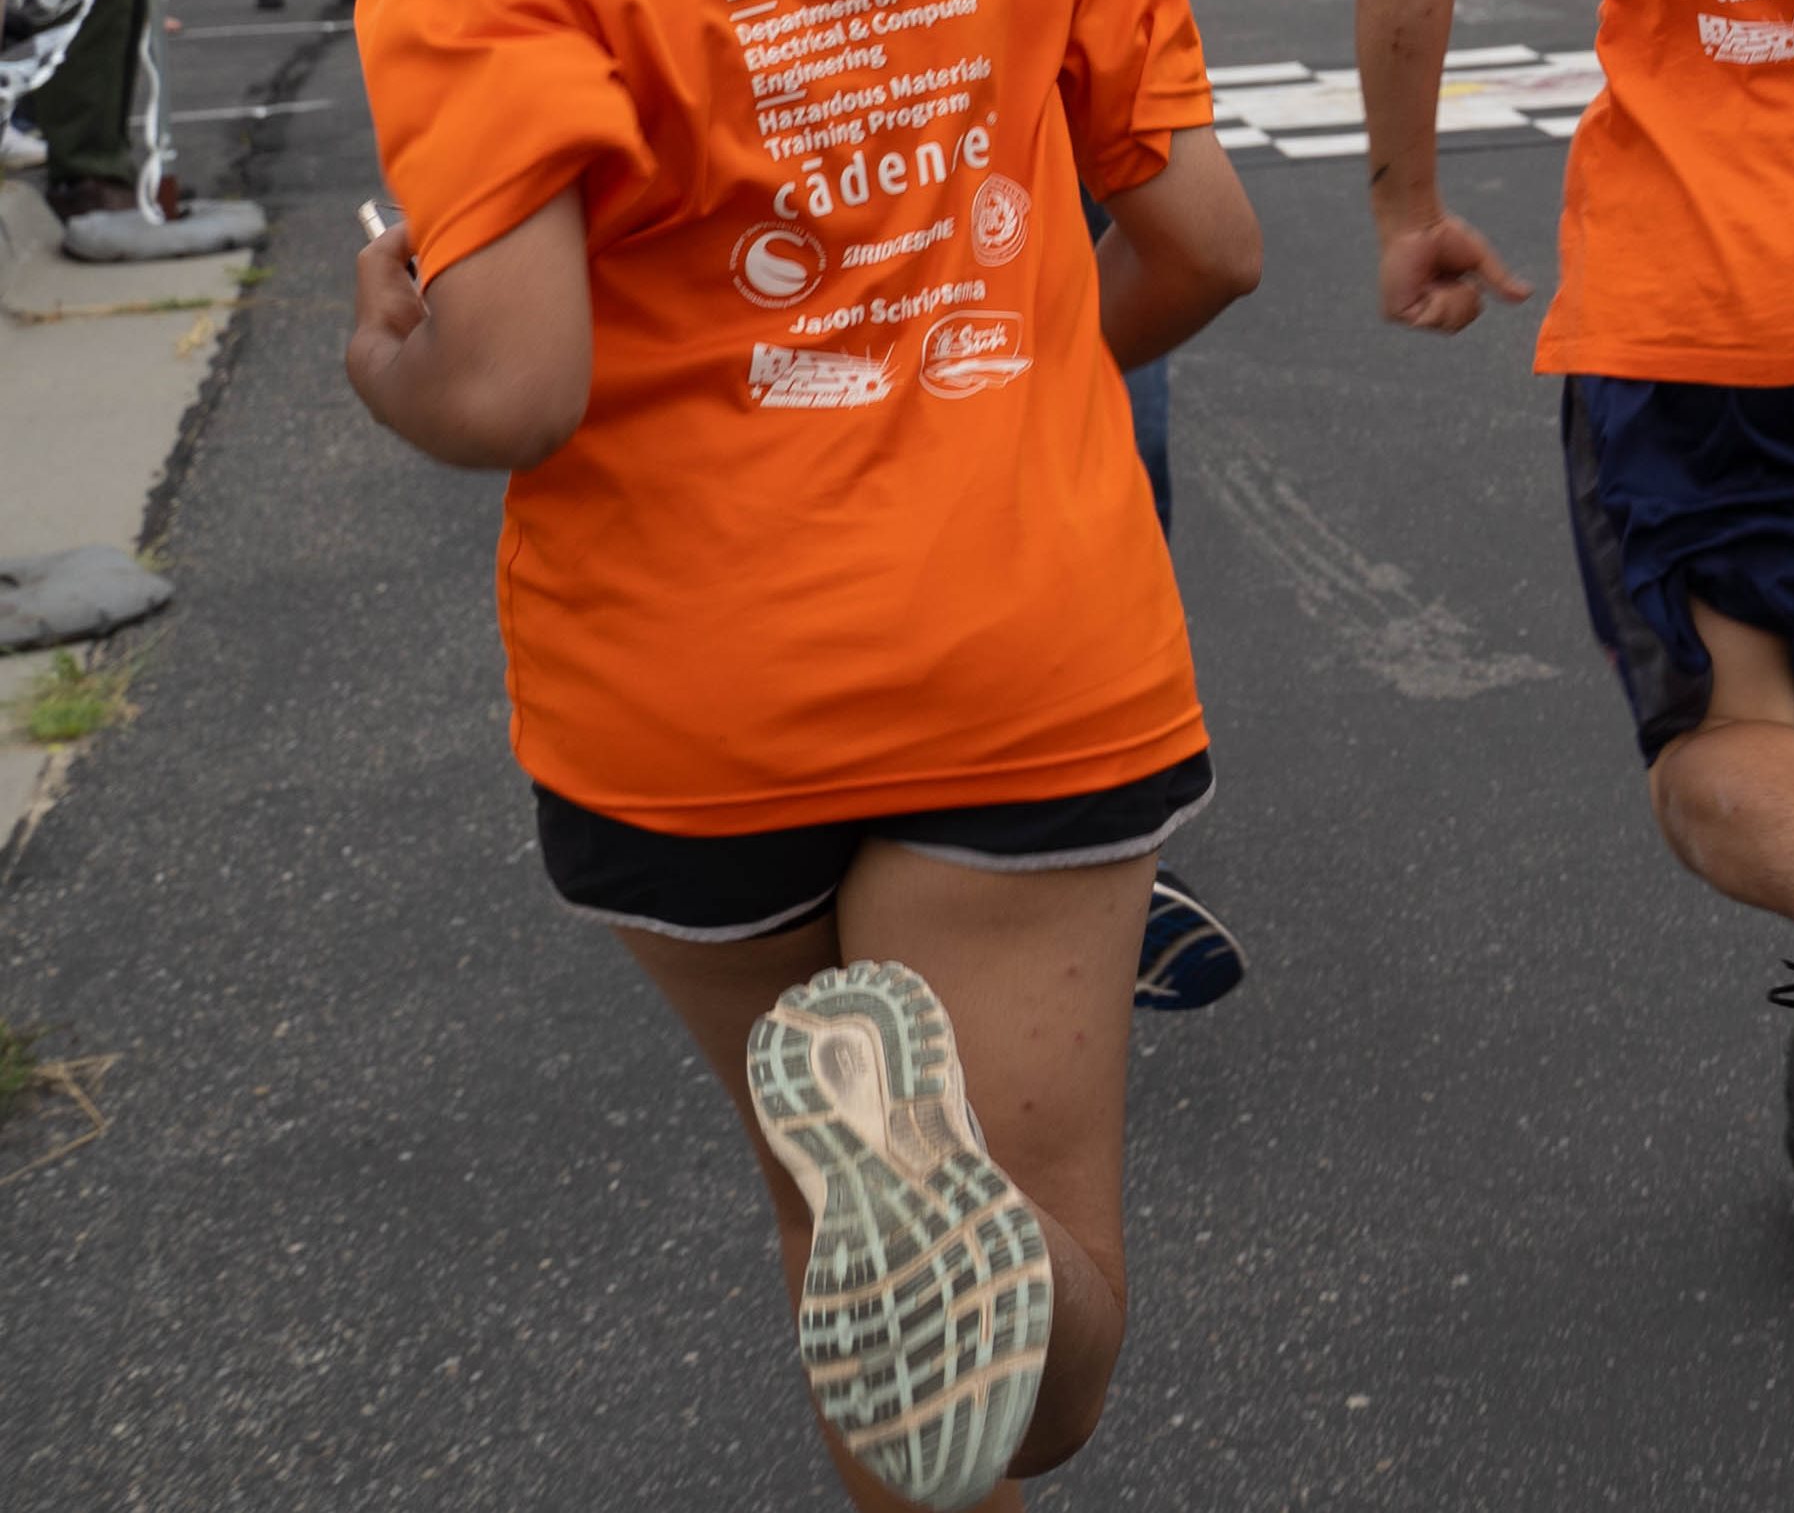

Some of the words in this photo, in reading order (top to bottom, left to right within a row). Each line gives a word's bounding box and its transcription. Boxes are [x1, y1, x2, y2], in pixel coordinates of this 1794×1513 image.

[744, 22, 845, 71] Electrical
[849, 18, 869, 41] &
[751, 43, 888, 98] Engineering
[757, 85, 887, 136] Hazardous
[890, 54, 992, 99] Materials
[764, 119, 866, 162] Training
[868, 92, 971, 136] Program
[789, 303, 865, 335] Jason
